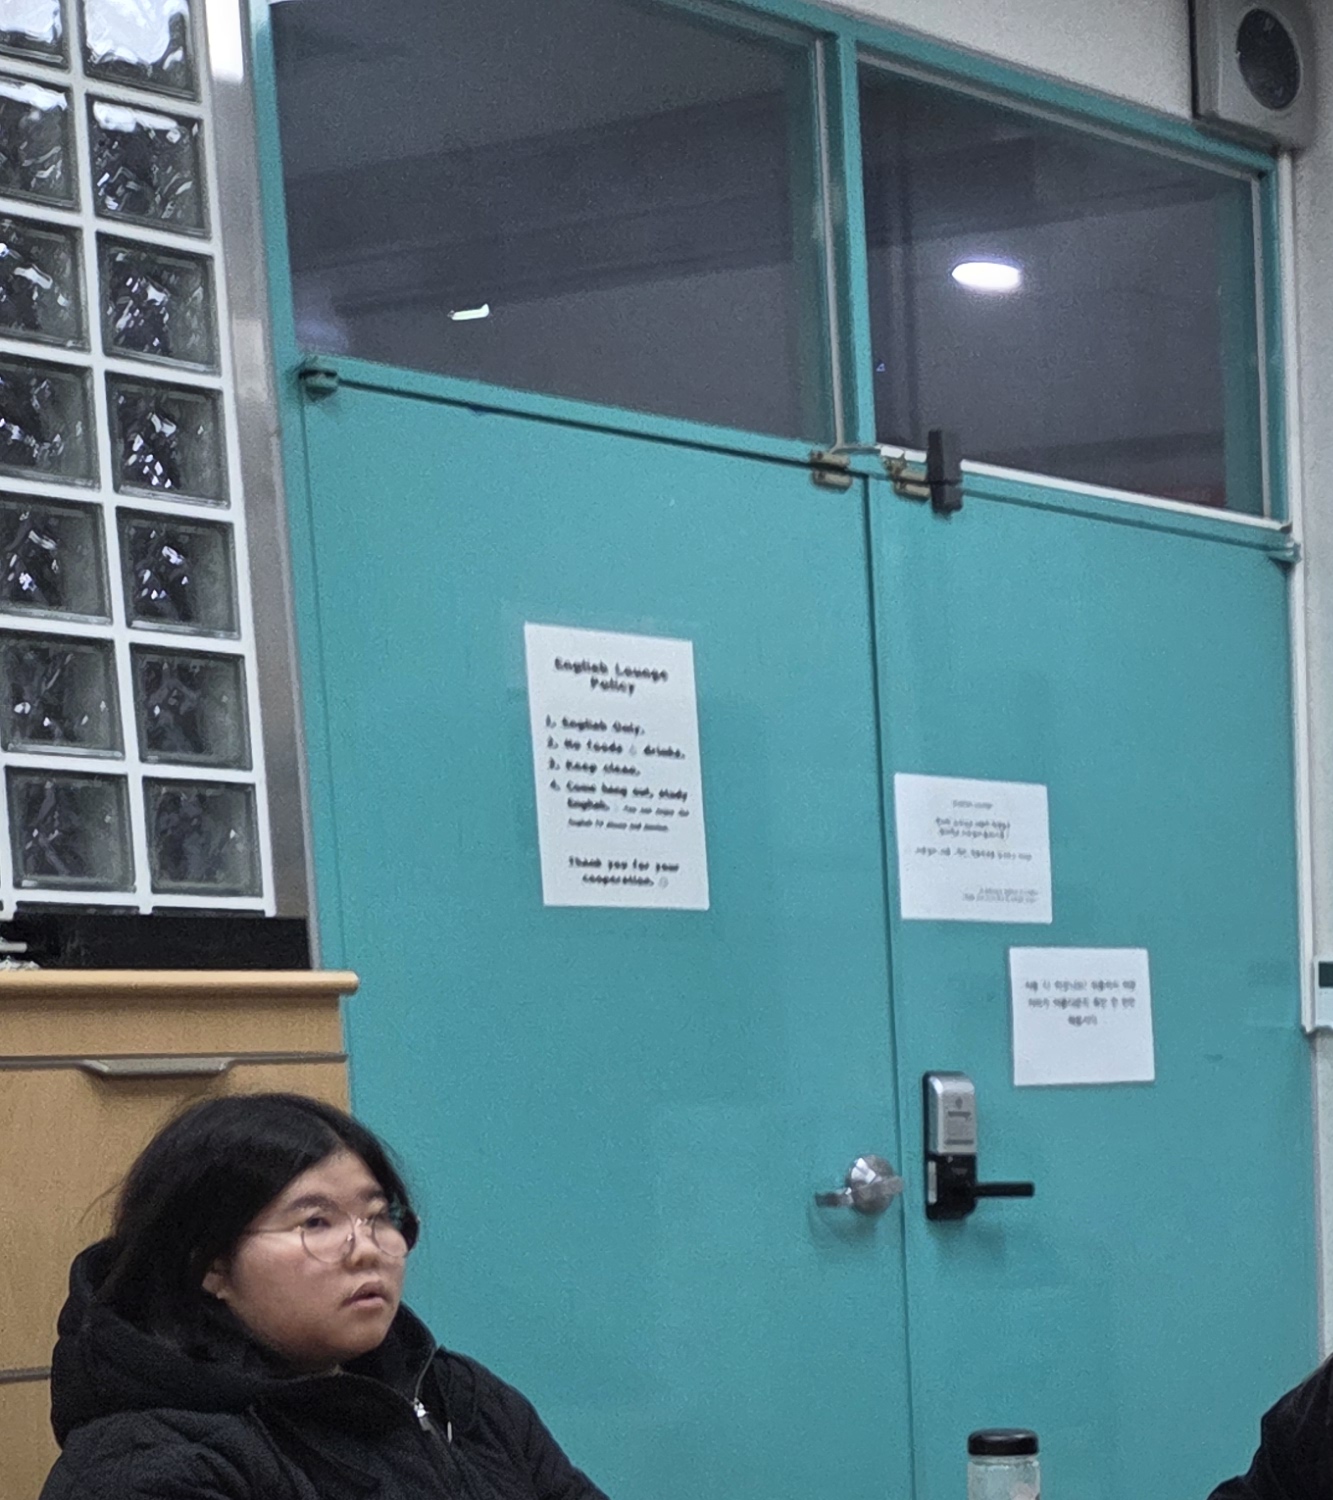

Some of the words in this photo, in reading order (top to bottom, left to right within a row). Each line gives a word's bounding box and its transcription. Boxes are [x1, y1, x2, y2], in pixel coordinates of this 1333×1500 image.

[554, 656, 608, 674] English
[615, 662, 668, 682] Lounge
[590, 676, 635, 697] Policy
[562, 716, 607, 732] English
[565, 759, 597, 776] Keep
[566, 779, 596, 793] Come
[601, 781, 627, 798] hang
[659, 787, 688, 803] study
[568, 855, 602, 868] Thank
[608, 859, 628, 873] you
[632, 857, 650, 872] for
[655, 861, 679, 875] your
